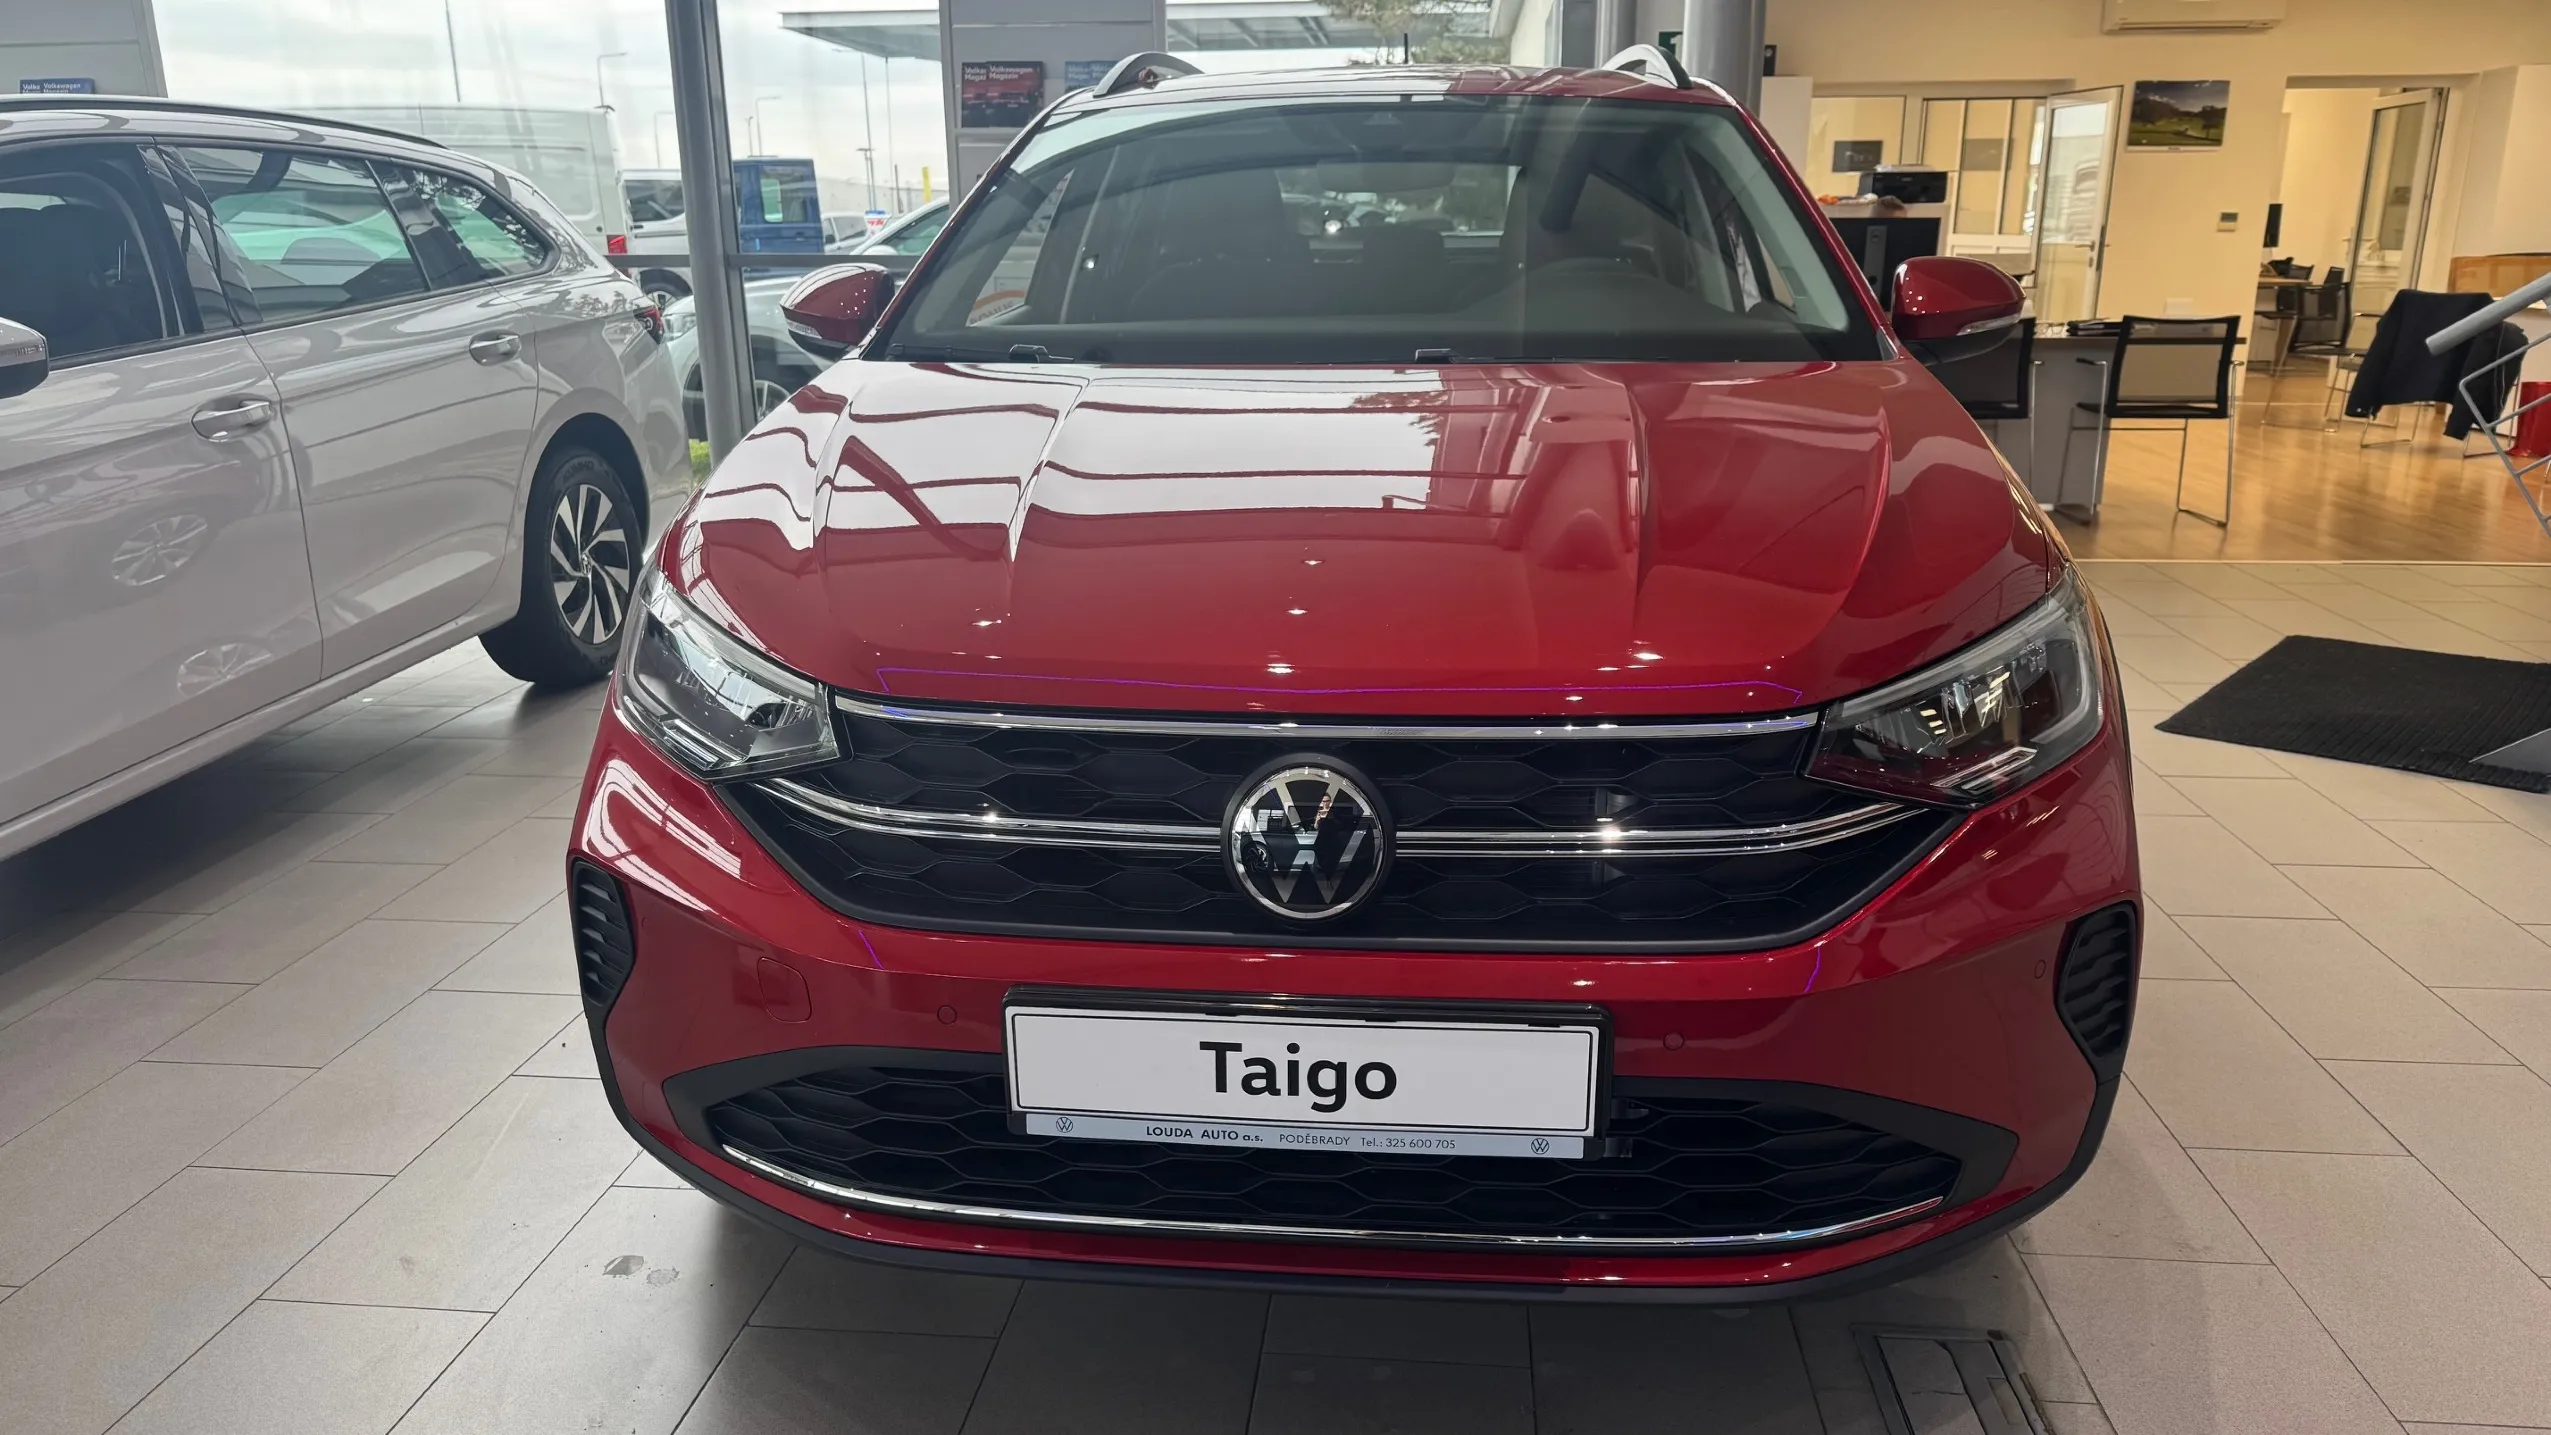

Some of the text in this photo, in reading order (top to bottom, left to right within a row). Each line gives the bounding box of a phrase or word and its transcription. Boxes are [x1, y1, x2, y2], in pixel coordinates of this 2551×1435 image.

[1199, 1041, 1397, 1113] Taigo
[1146, 1126, 1194, 1139] LOUDA
[1200, 1129, 1239, 1141] AUTO
[1242, 1133, 1264, 1142] a.s.
[1361, 1137, 1383, 1147] Tel.:
[1386, 1138, 1406, 1148] 325
[1409, 1139, 1432, 1149] 600
[1435, 1139, 1456, 1149] 705
